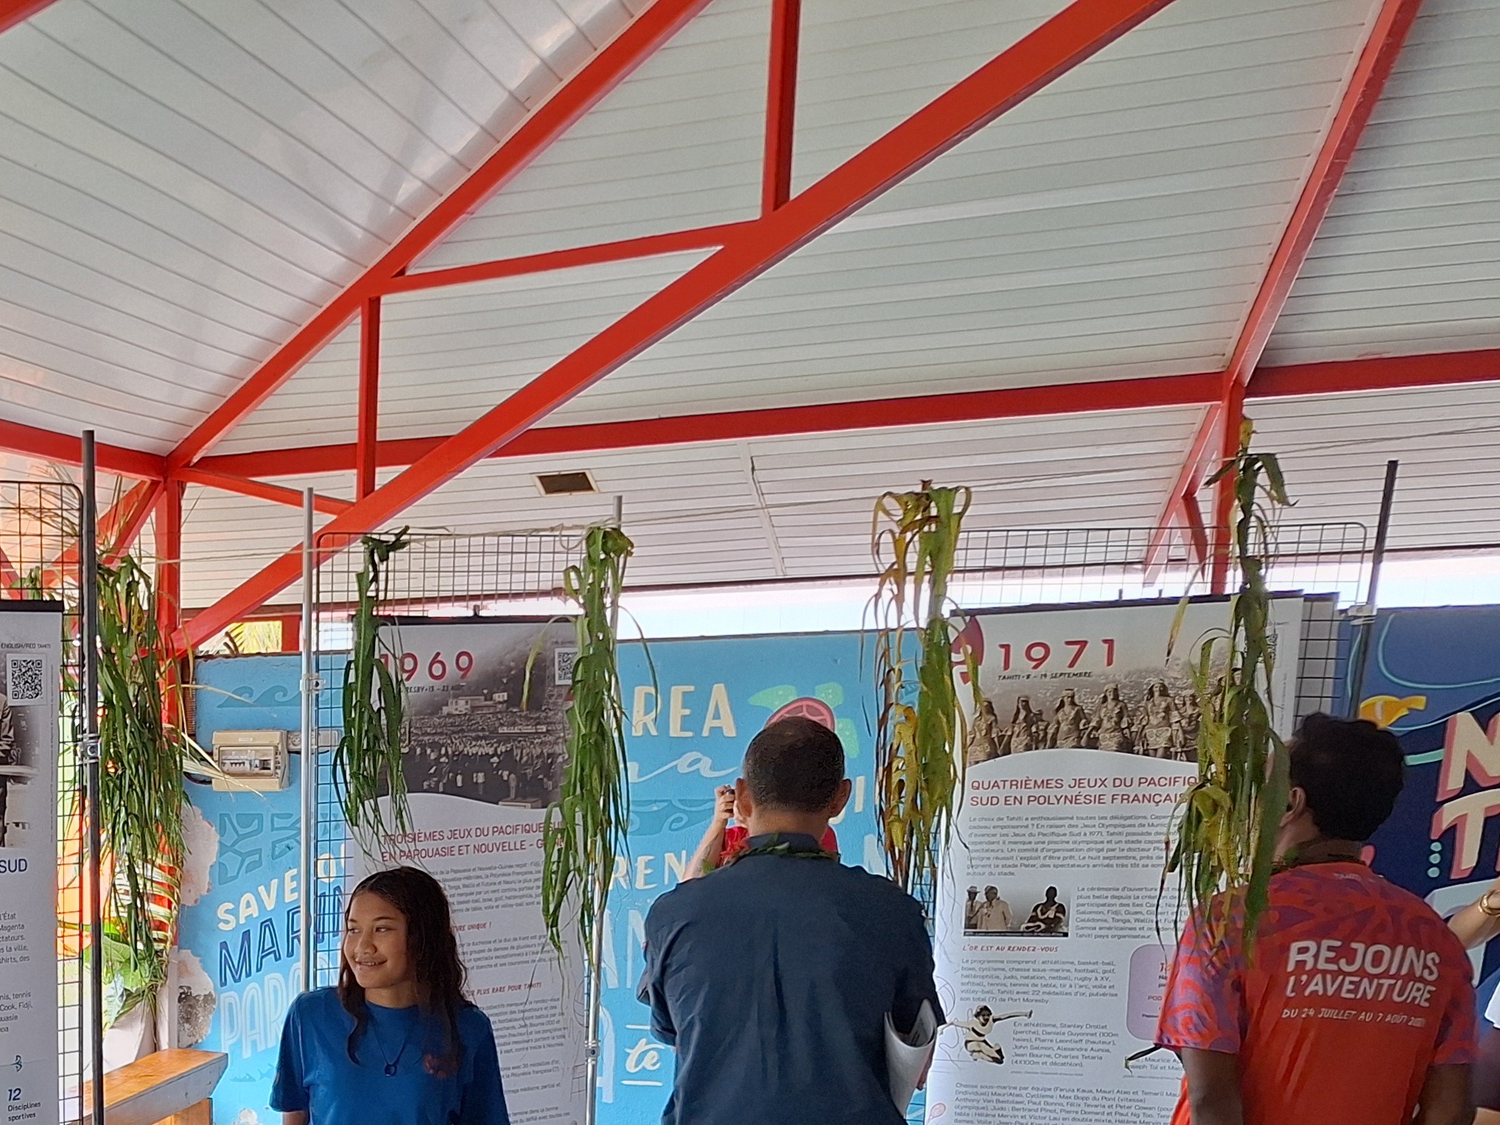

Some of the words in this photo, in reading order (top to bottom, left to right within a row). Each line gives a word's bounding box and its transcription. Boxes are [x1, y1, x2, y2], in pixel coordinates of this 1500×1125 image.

[998, 639, 1115, 671] 1971
[1050, 671, 1093, 679] SEPTEMBRE
[634, 683, 737, 738] REA
[971, 775, 1064, 791] QUATRIÈMES
[1068, 777, 1108, 789] JEUX
[1112, 776, 1134, 788] DU
[1138, 775, 1199, 788] PACIFIQ
[970, 795, 1000, 807] SUD
[1004, 794, 1024, 806] EN
[1027, 791, 1107, 806] POLYNÉSIE
[382, 829, 445, 845] TROISIÈMES
[447, 826, 473, 839] JEUX
[475, 825, 487, 837] DU
[492, 822, 545, 835] PACIFIQUE
[400, 844, 456, 860] PAPOUASIE
[458, 843, 470, 855] ET
[473, 839, 526, 853] NOUVELLE
[217, 867, 298, 932] SAVE
[1286, 939, 1440, 981] REJOINS
[492, 986, 506, 994] RARE
[1282, 1009, 1298, 1019] DU
[1318, 1008, 1356, 1020] JUILLET
[1358, 1013, 1374, 1022] AU
[1376, 1014, 1384, 1022] 7
[1060, 1023, 1084, 1031] Stanley
[8, 1088, 21, 1101] 12
[8, 1102, 41, 1111] Disciplines
[8, 1113, 36, 1122] sportives
